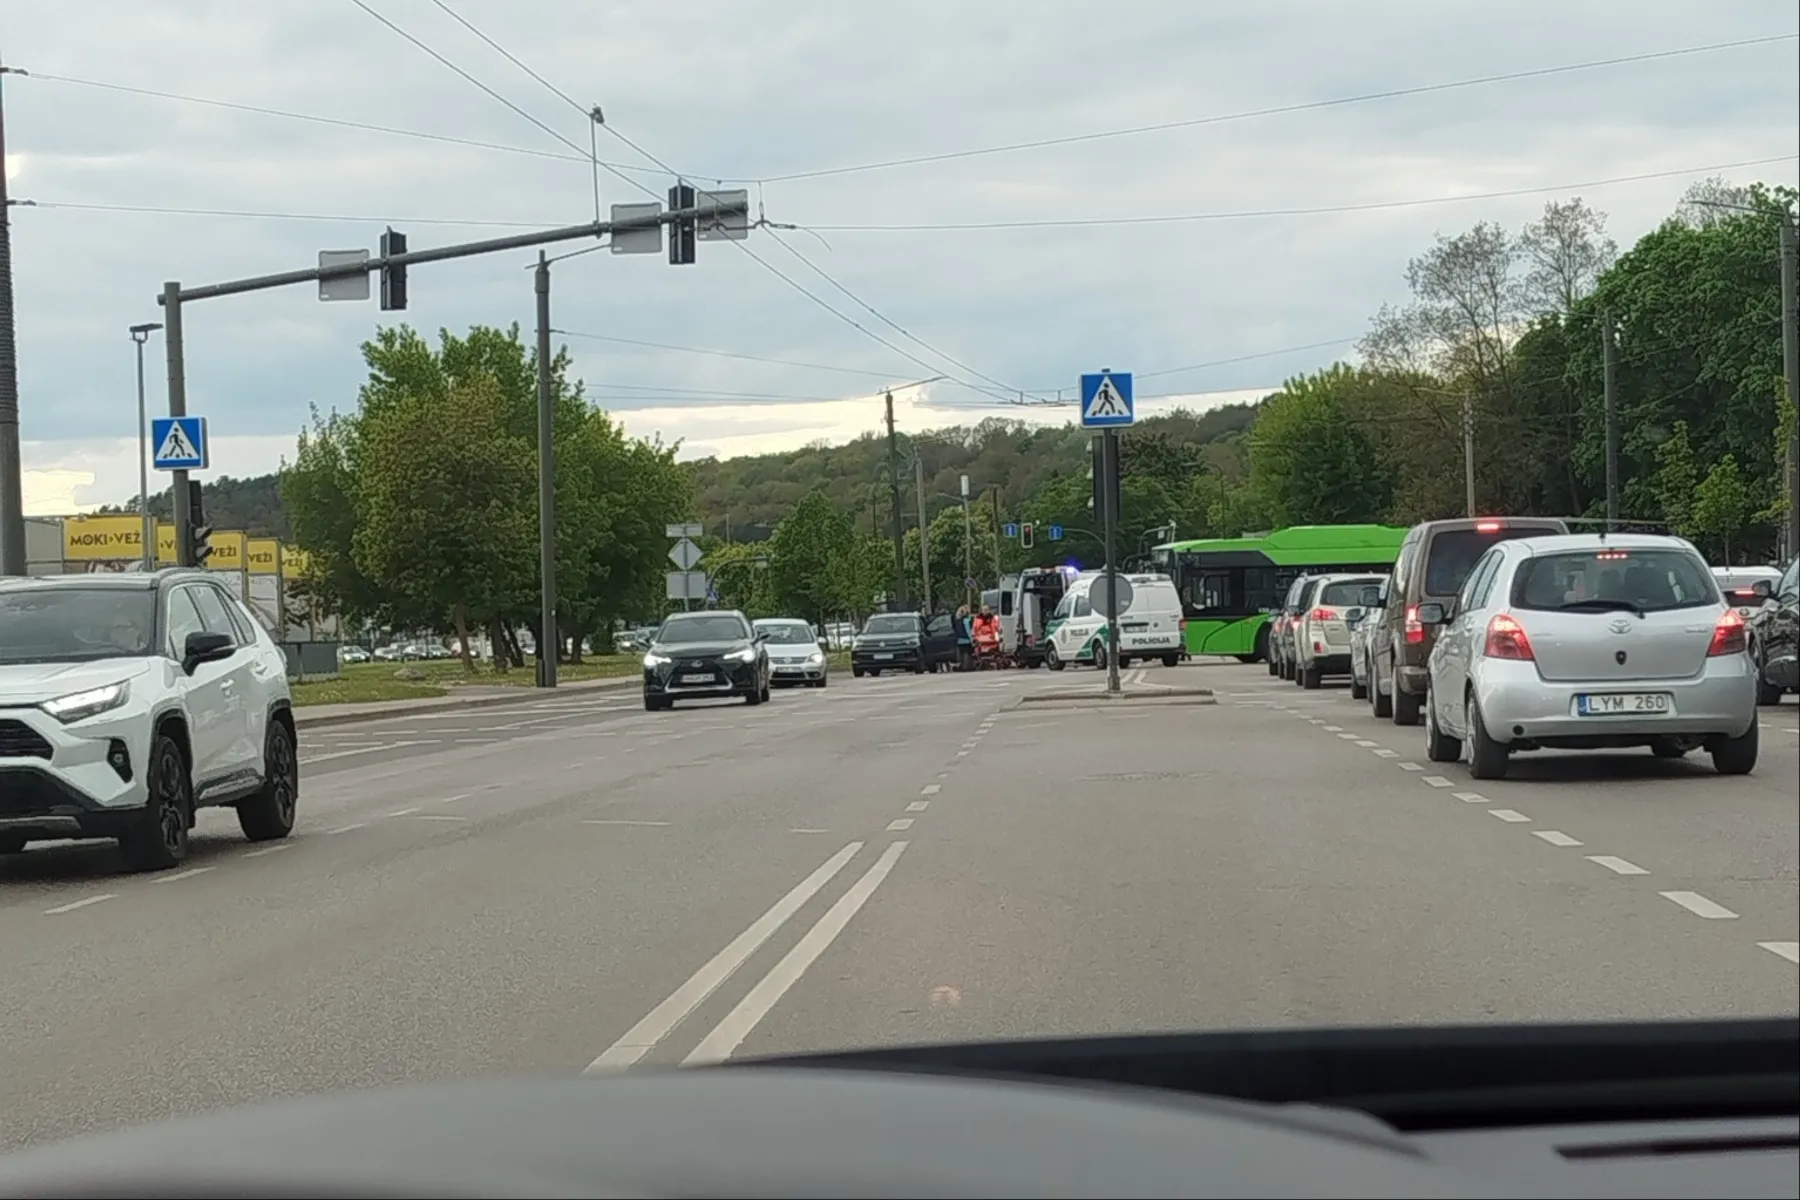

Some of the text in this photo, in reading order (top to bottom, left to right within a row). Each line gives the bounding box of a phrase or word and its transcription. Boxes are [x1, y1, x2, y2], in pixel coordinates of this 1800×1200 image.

[1132, 637, 1171, 645] POLICIJA
[1588, 695, 1665, 711] LYM 260
